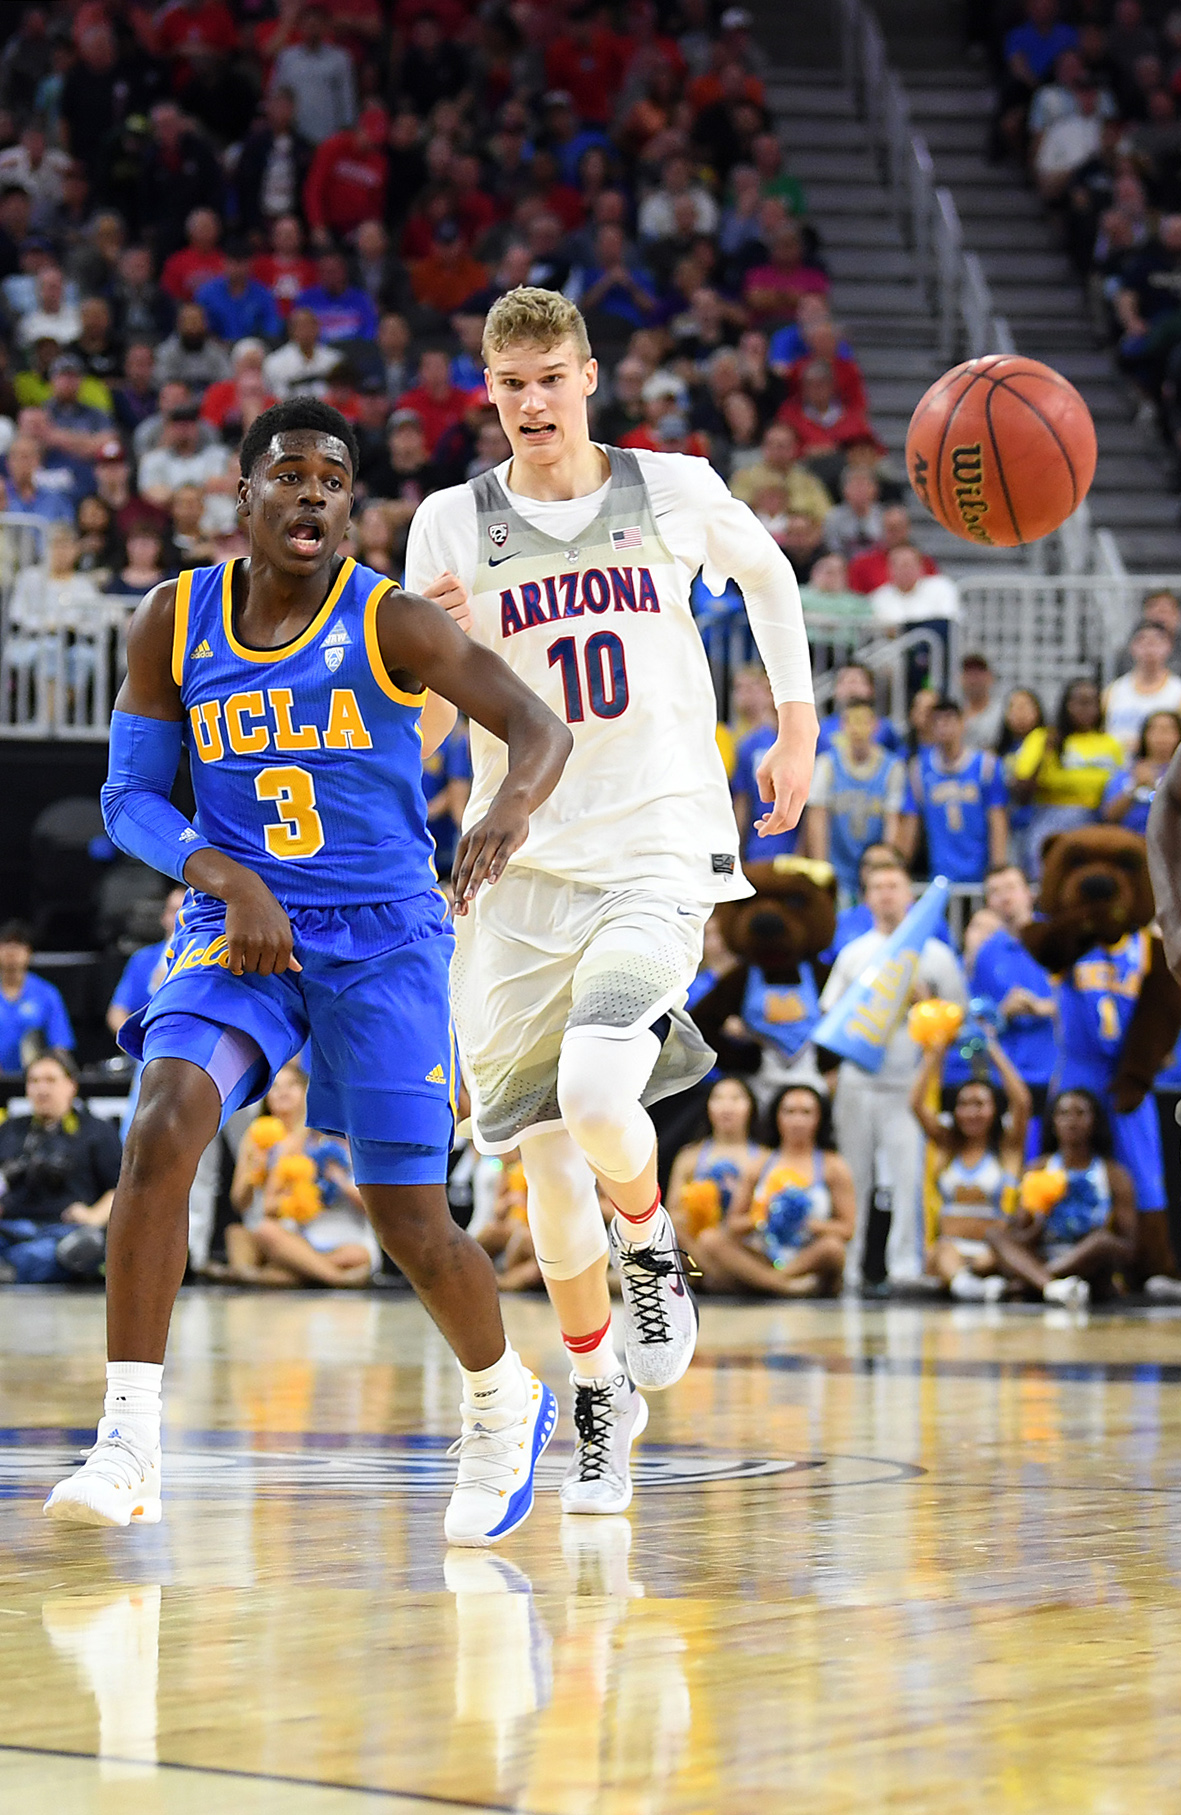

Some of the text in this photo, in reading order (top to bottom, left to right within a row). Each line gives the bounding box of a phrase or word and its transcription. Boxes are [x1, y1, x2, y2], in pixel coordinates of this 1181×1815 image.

[951, 442, 993, 546] Wilso
[499, 566, 661, 639] ARIZONA
[547, 630, 630, 724] 10
[189, 688, 374, 764] UCLA
[254, 765, 326, 861] 3
